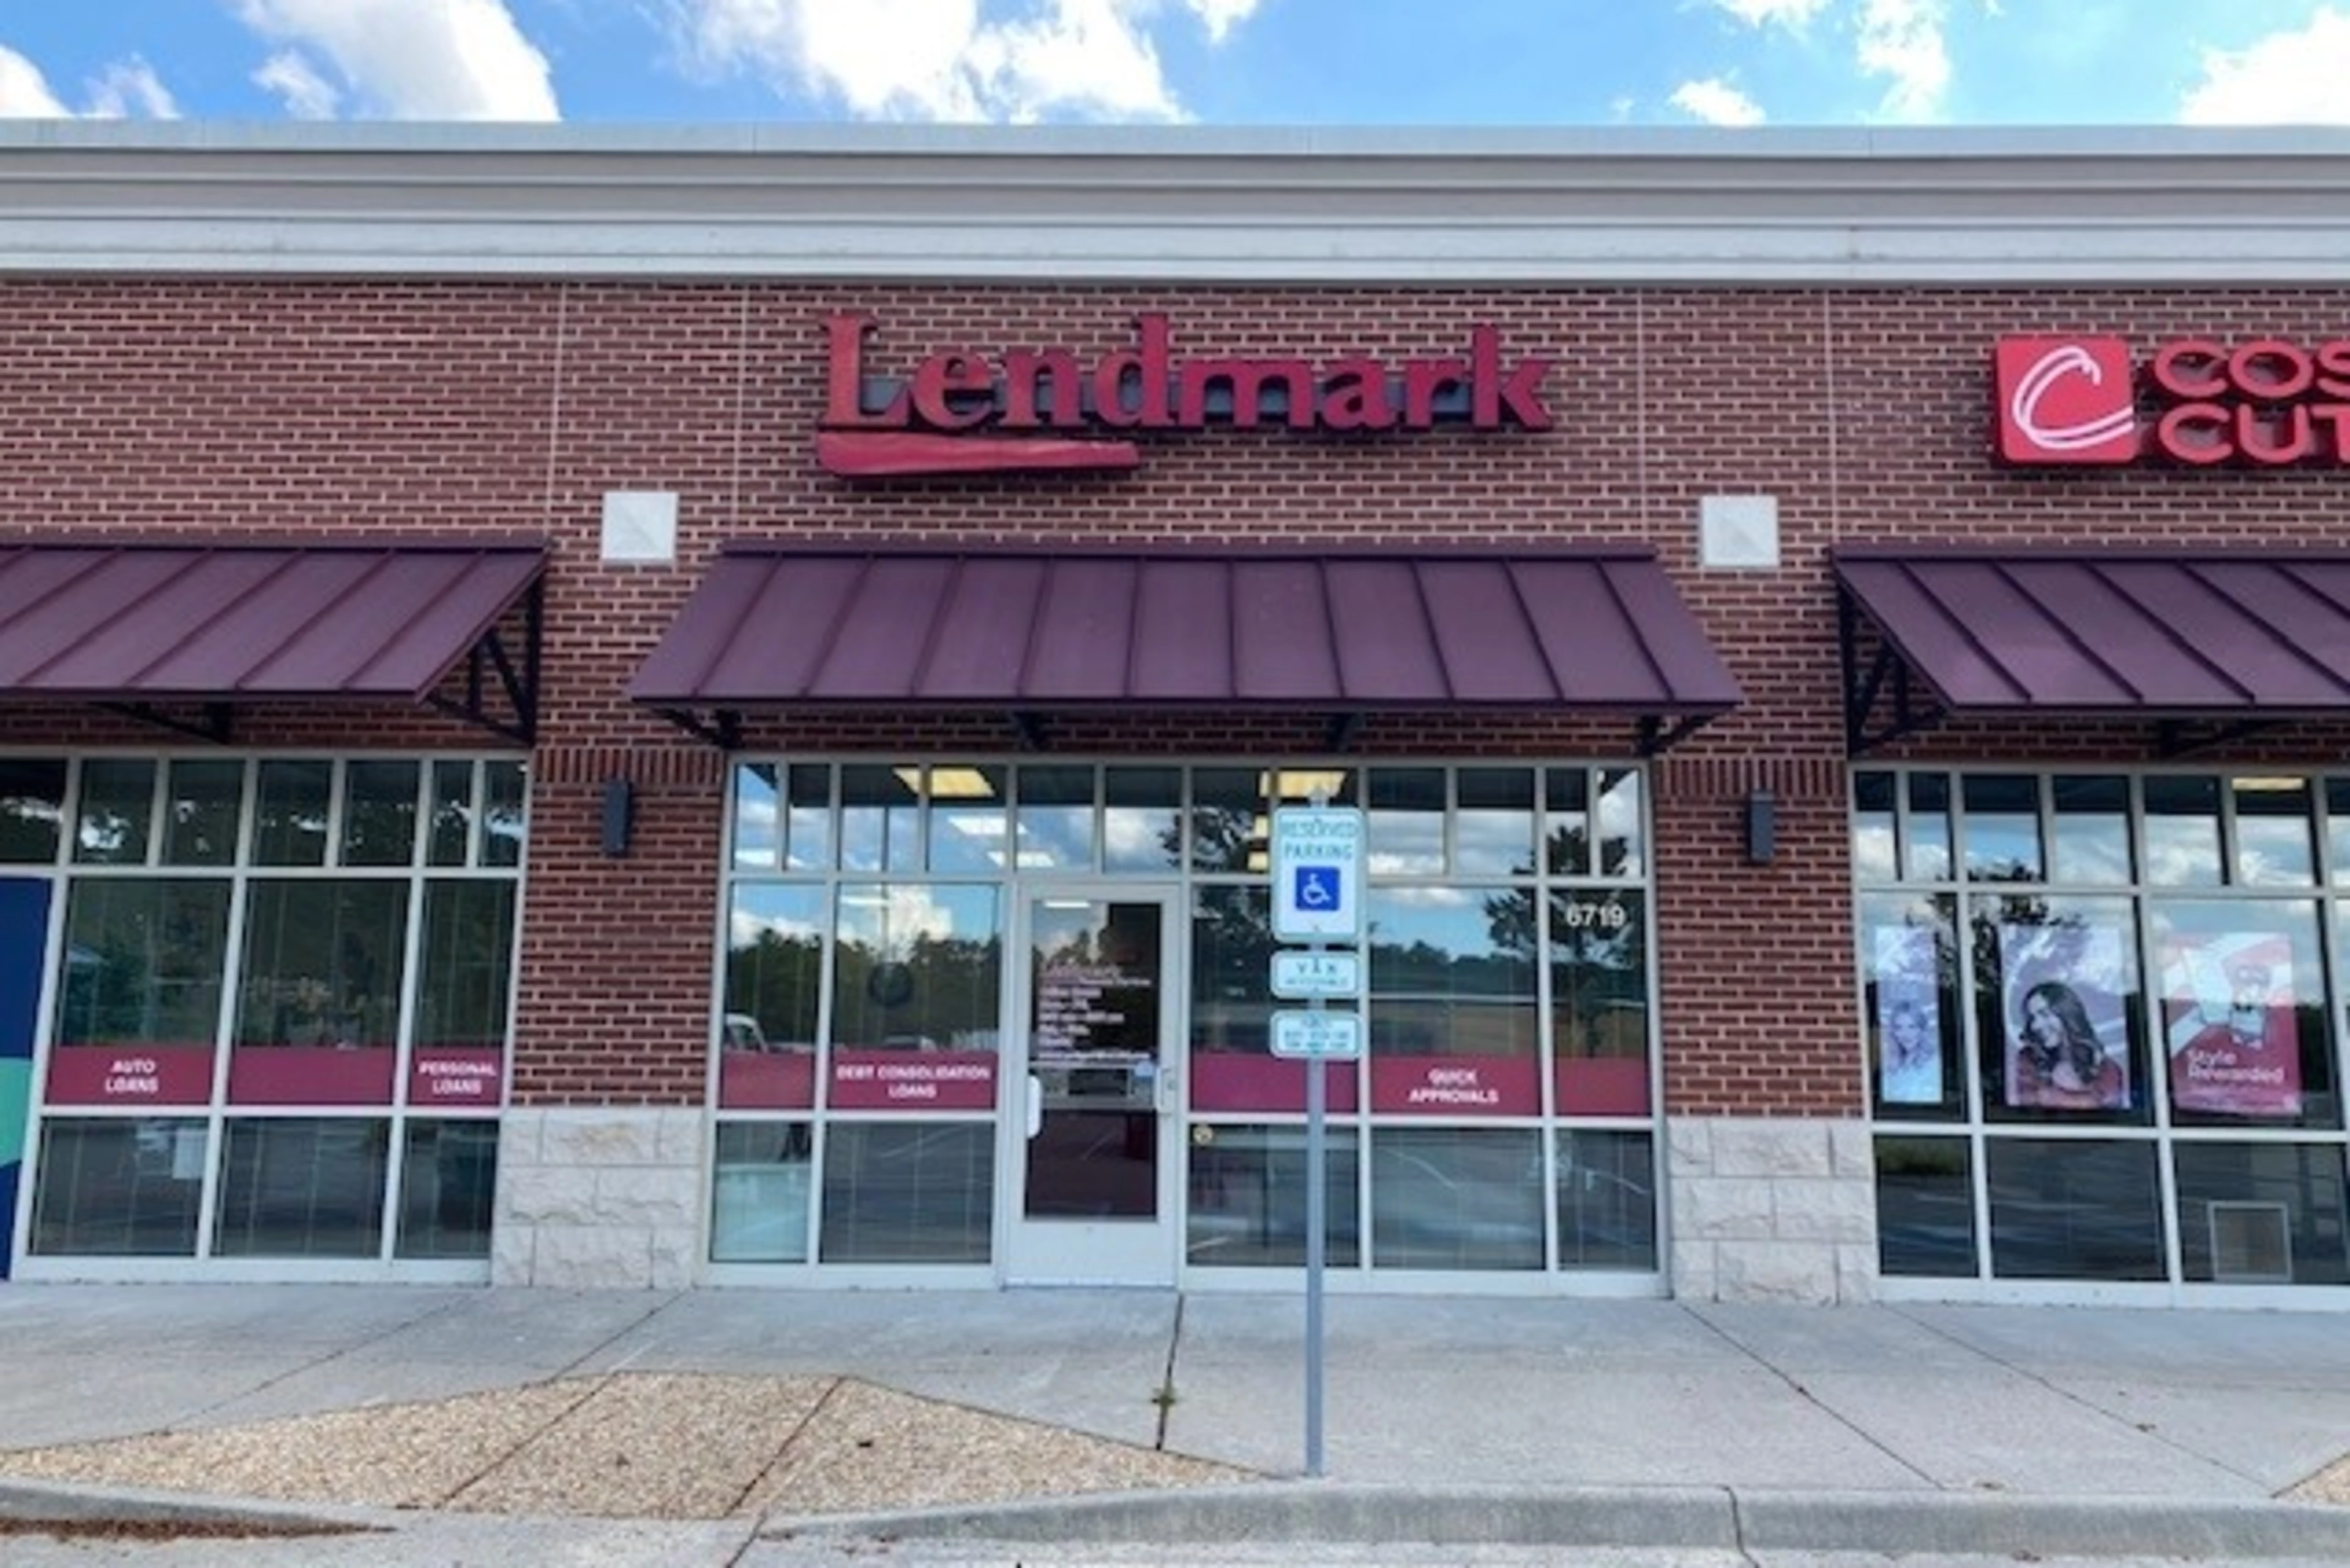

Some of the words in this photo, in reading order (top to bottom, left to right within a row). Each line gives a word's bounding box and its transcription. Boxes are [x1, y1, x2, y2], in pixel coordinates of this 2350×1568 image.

[817, 313, 1555, 428] Lendmark
[1280, 821, 1357, 838] RESERVED
[1285, 843, 1353, 859] PARKING
[1565, 902, 1626, 928] 6719
[110, 1059, 156, 1073] AUTO
[419, 1061, 498, 1076] PERSONAL
[837, 1065, 875, 1080] DEBT
[877, 1065, 991, 1080] CONSOLIDATION
[1428, 1068, 1477, 1086] QUICK
[105, 1077, 159, 1094] LOANS
[432, 1078, 482, 1094] LOANS
[888, 1083, 937, 1099] LOANS
[1408, 1088, 1499, 1104] APPROVALS
